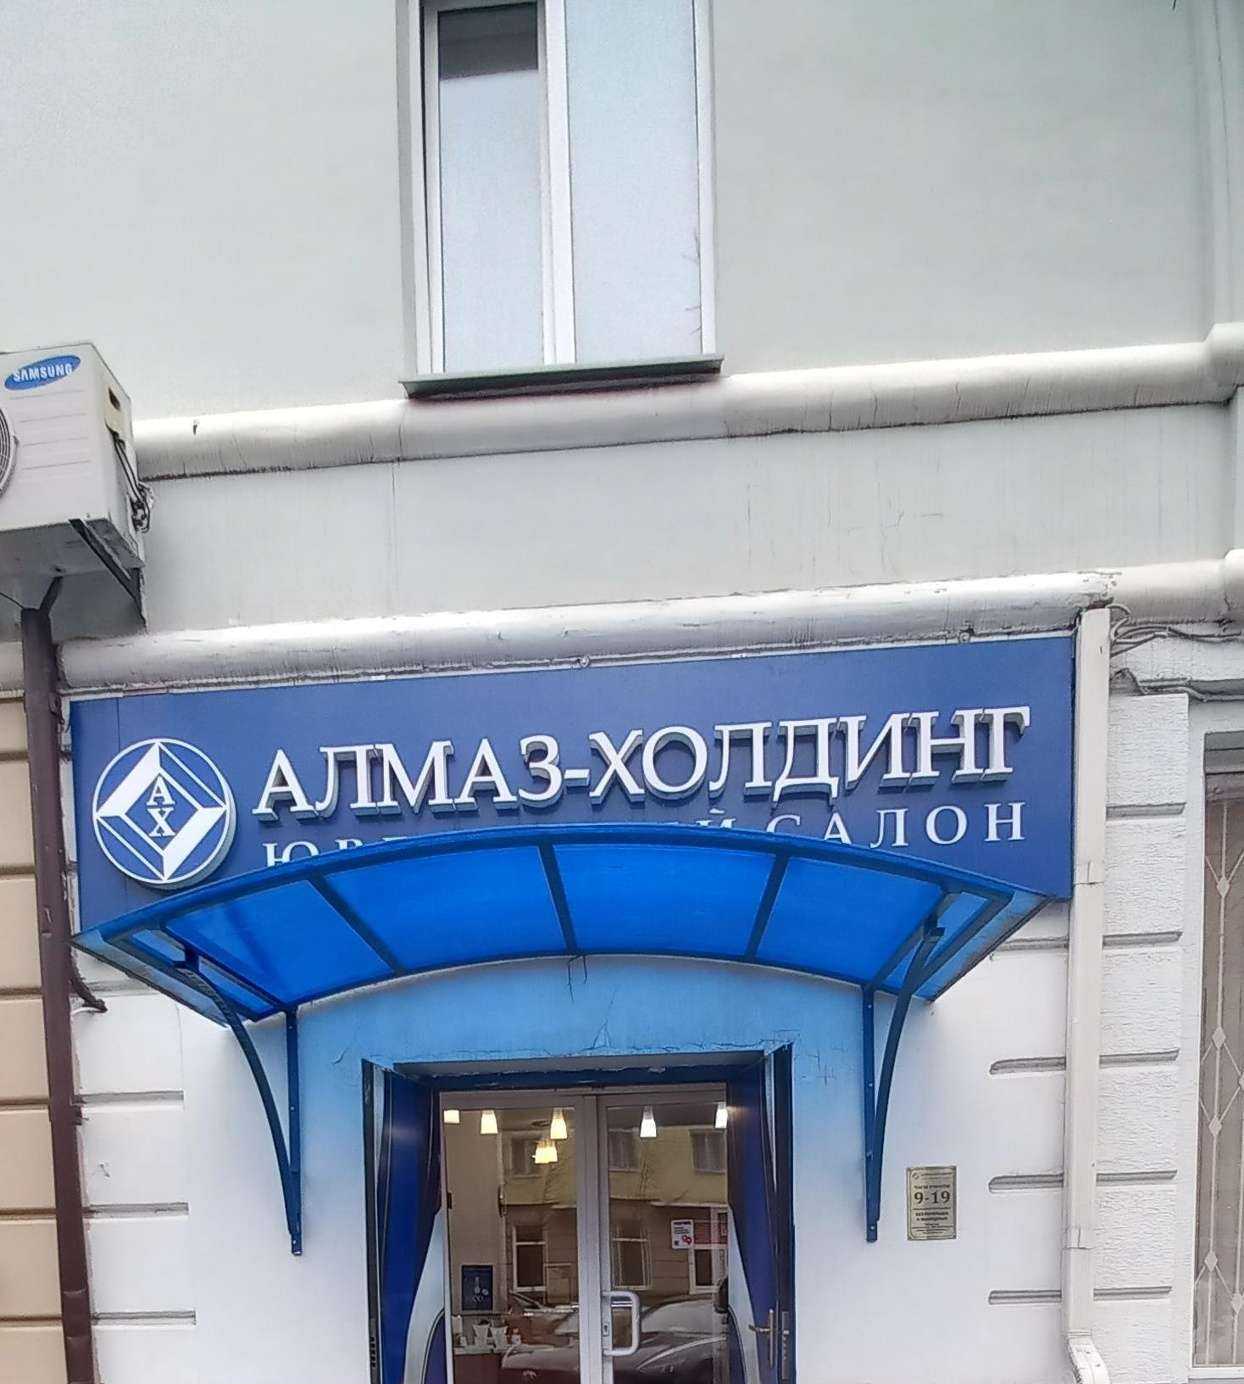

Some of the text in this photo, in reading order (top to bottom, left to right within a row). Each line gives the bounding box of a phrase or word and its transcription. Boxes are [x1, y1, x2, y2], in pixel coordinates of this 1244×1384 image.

[13, 363, 73, 382] SAMSUNG
[252, 706, 1030, 822] АЛМАЗ-ХОЛДИНГ
[914, 1191, 951, 1204] 9-19
